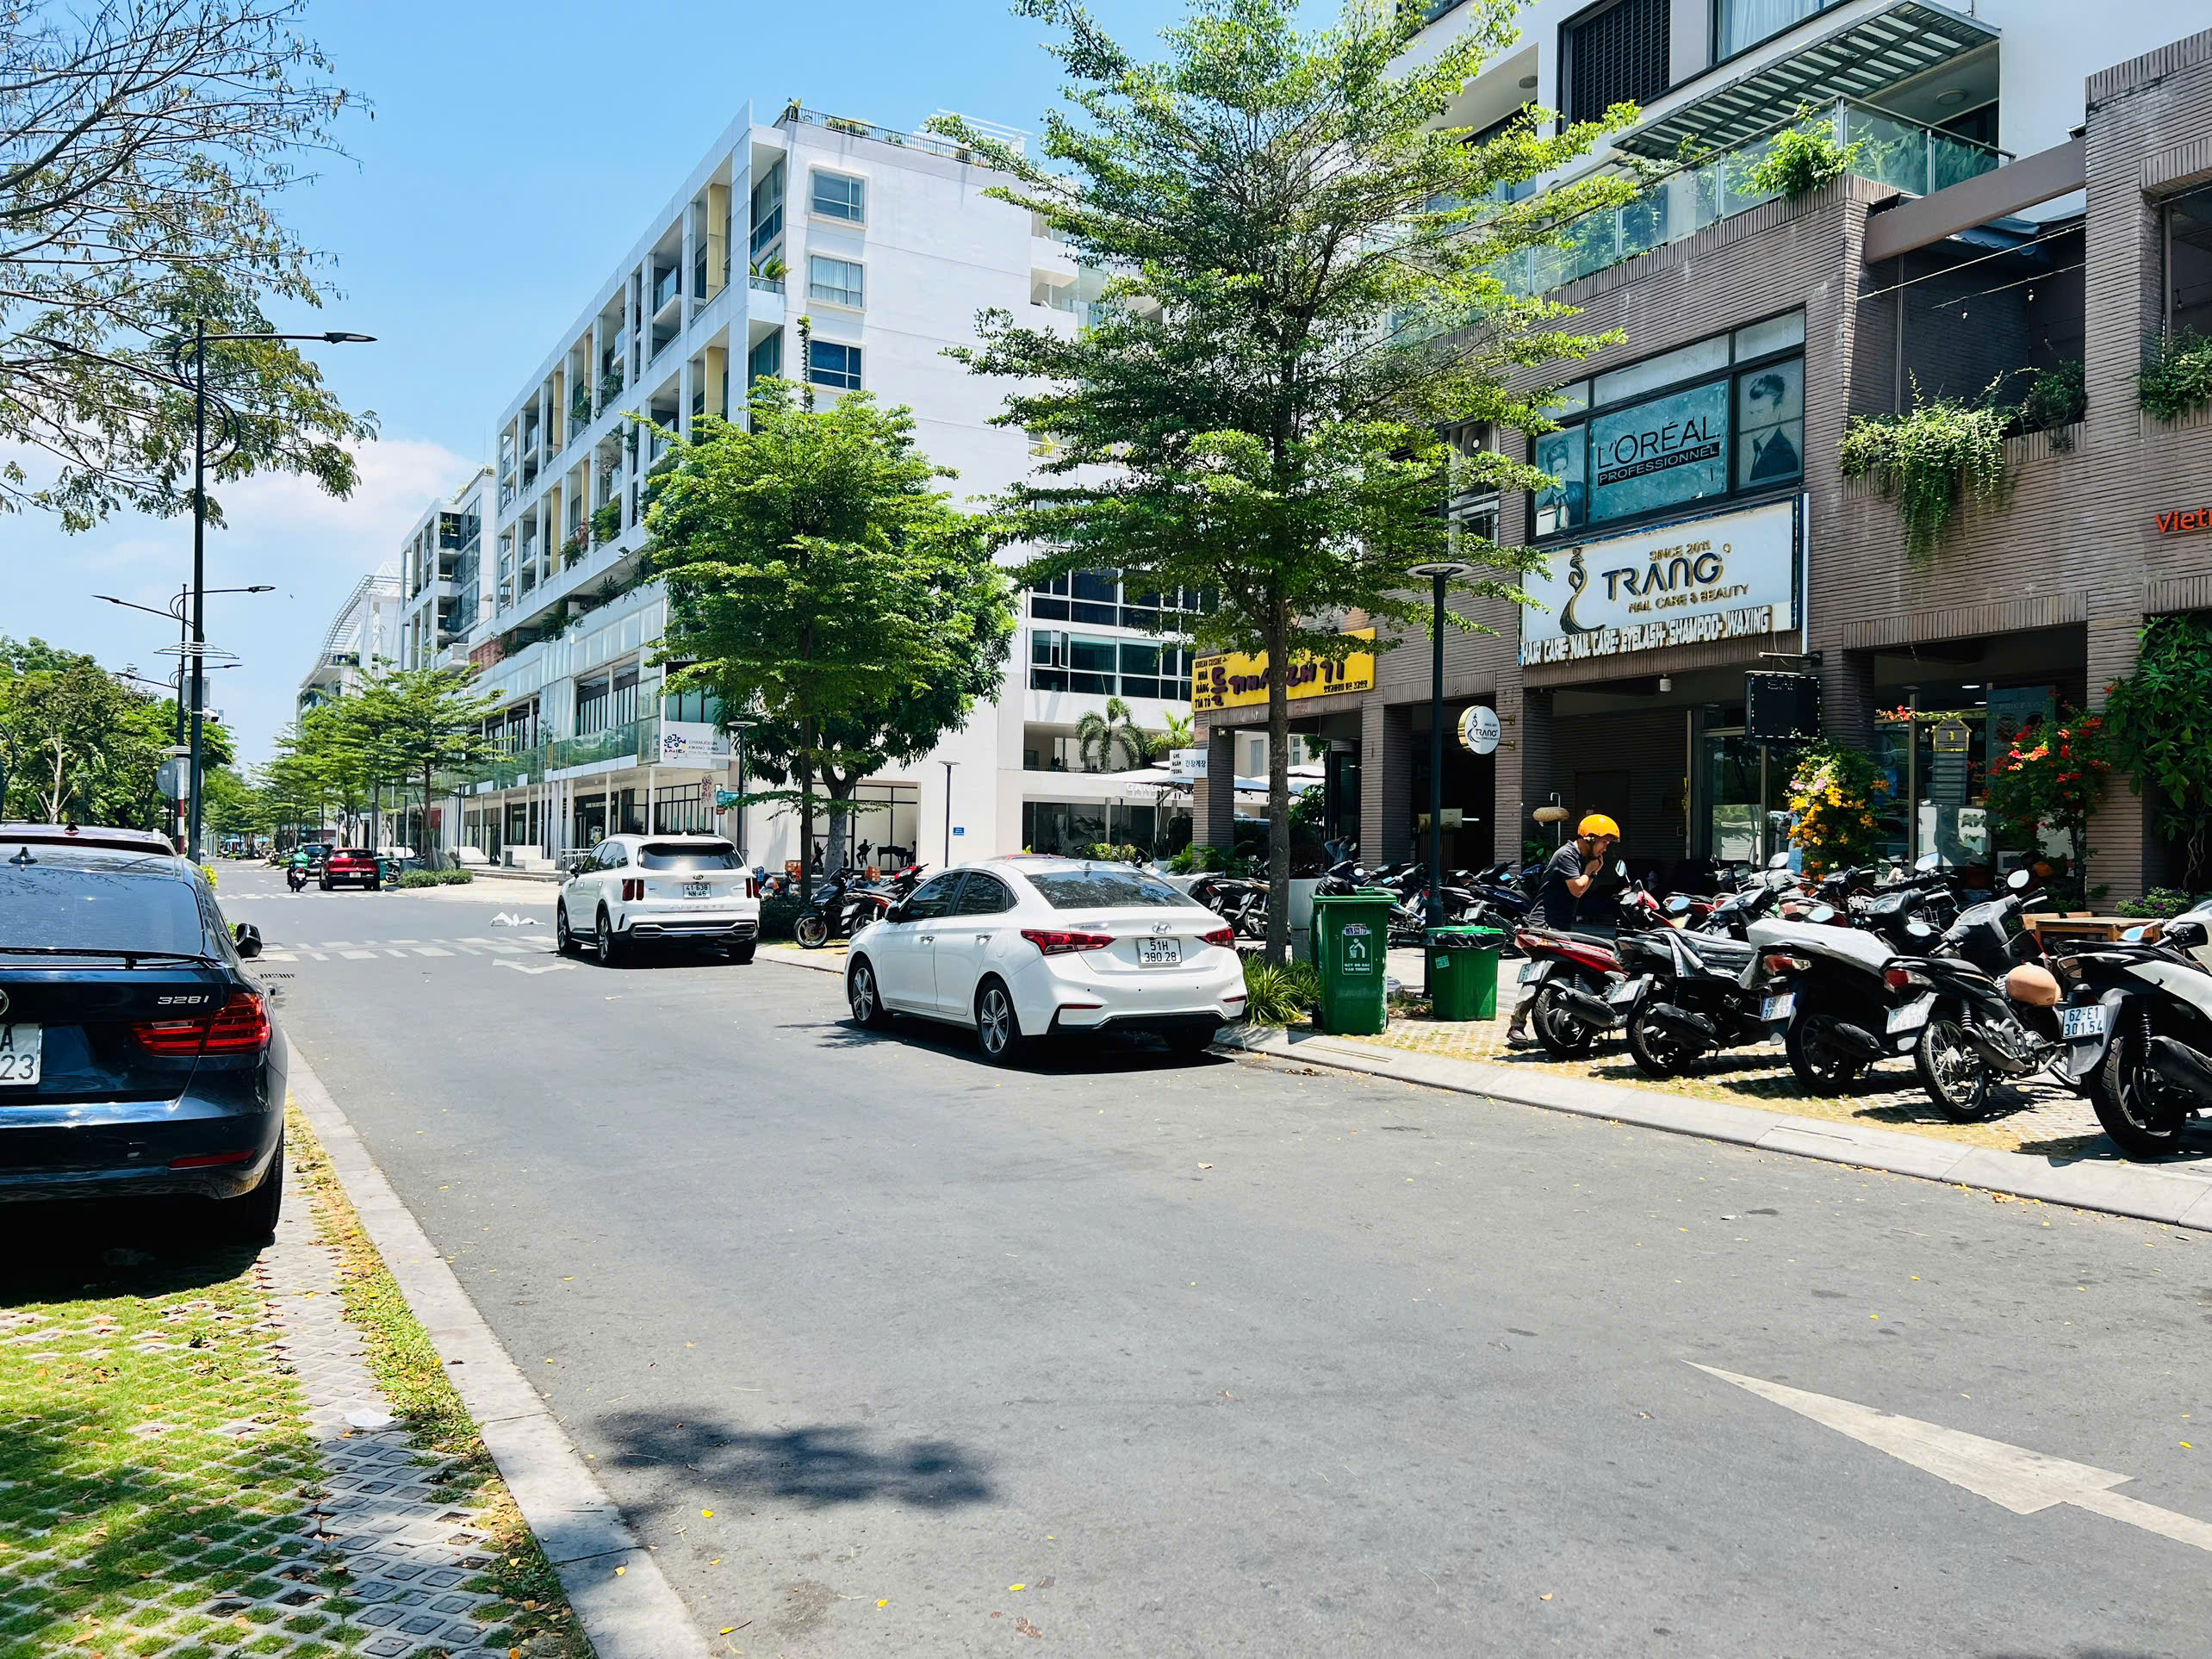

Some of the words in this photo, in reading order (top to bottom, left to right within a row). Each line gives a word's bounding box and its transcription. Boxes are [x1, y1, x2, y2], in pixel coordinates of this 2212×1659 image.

[1599, 444, 1718, 485] PROFESSIONNEL
[1649, 545, 1683, 561] SINCE
[1686, 540, 1711, 555] 2011
[1601, 552, 1724, 601] TRANG
[1629, 602, 1652, 613] NAIL
[1656, 593, 1688, 609] CARE
[1690, 593, 1699, 604] &
[1700, 584, 1749, 602] BEAUTY
[1521, 641, 1542, 666] HAIR
[1570, 634, 1593, 659] NAIL
[1726, 605, 1772, 637] WAXING
[1196, 660, 1208, 668] KOREAN
[1196, 681, 1209, 694] HÀNG
[1150, 941, 1169, 951] 51H
[2069, 1007, 2098, 1022] 62-E1
